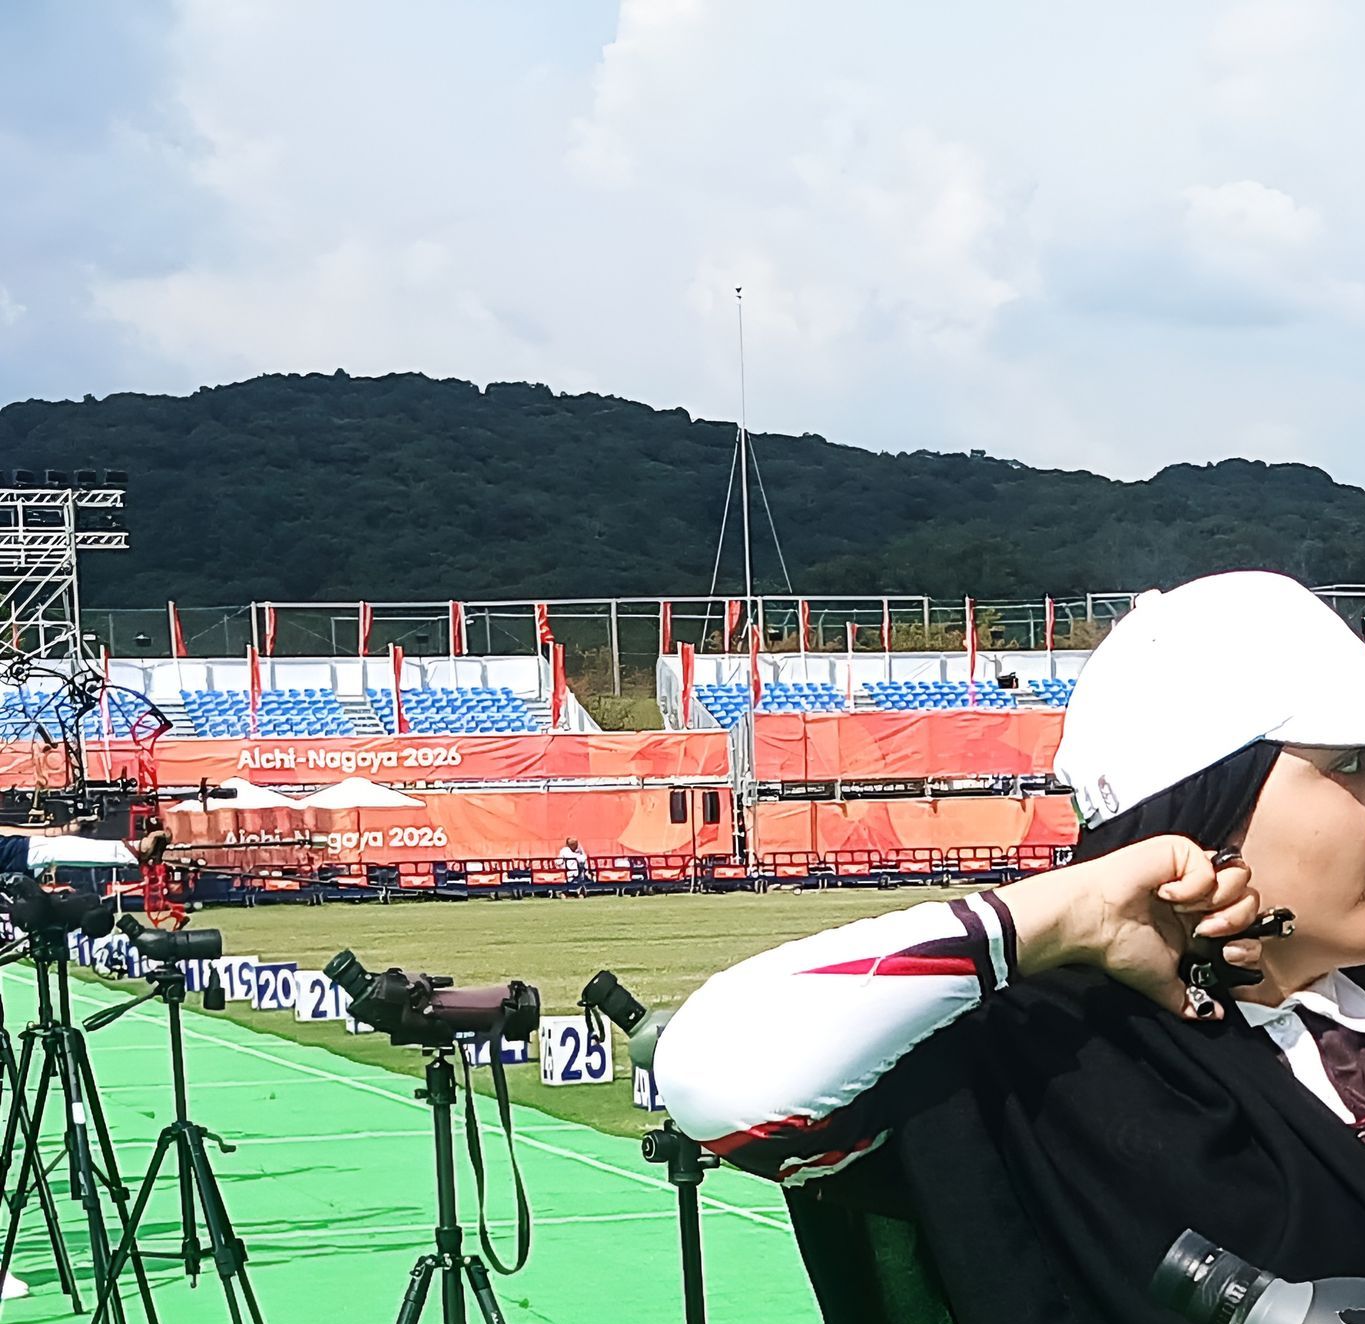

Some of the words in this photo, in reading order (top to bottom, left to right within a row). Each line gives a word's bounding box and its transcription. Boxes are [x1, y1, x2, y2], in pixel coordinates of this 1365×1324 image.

[237, 746, 398, 774] Aichi-Nagoya
[403, 746, 462, 768] 2026
[388, 826, 448, 848] 2026
[258, 969, 296, 1008] 20
[309, 979, 340, 1018] 21
[559, 1027, 607, 1081] 25
